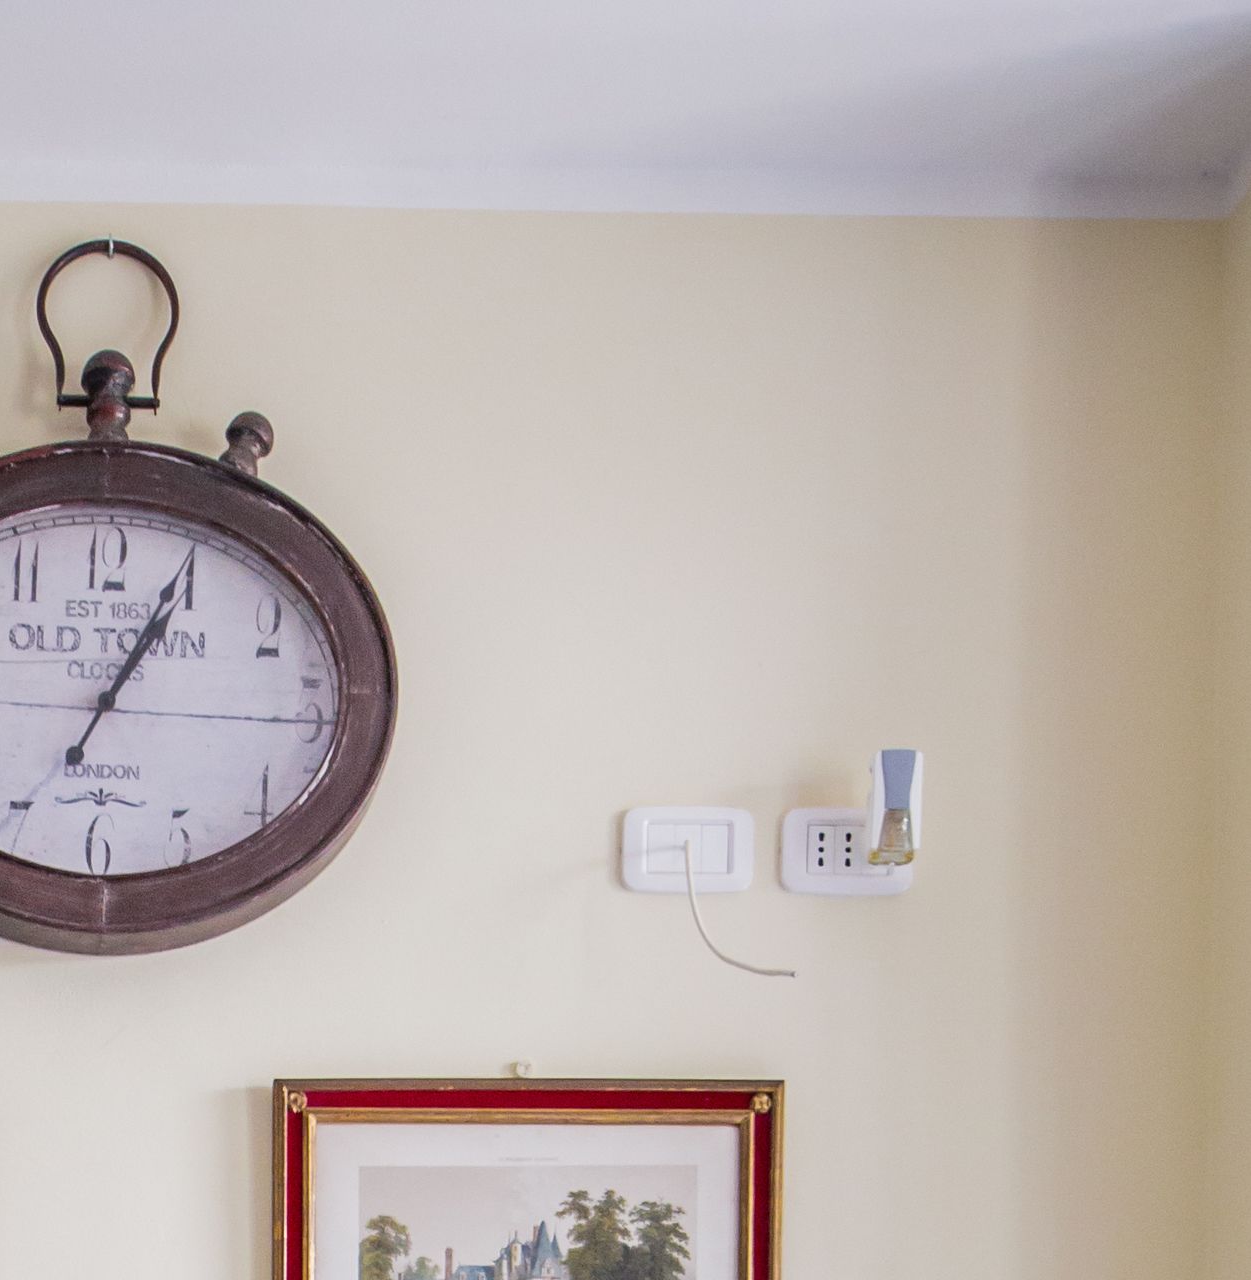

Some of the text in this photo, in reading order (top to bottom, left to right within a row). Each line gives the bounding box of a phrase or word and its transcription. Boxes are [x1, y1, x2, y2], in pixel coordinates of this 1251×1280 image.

[13, 538, 40, 602] 11
[88, 526, 128, 592] 12
[180, 543, 198, 611] 1
[8, 622, 82, 652] OLD
[65, 599, 151, 620] EST 1863
[255, 597, 282, 658] 2
[63, 763, 141, 780] LONDON
[243, 763, 274, 828] 4
[86, 813, 115, 875] 6
[162, 808, 191, 867] 5
